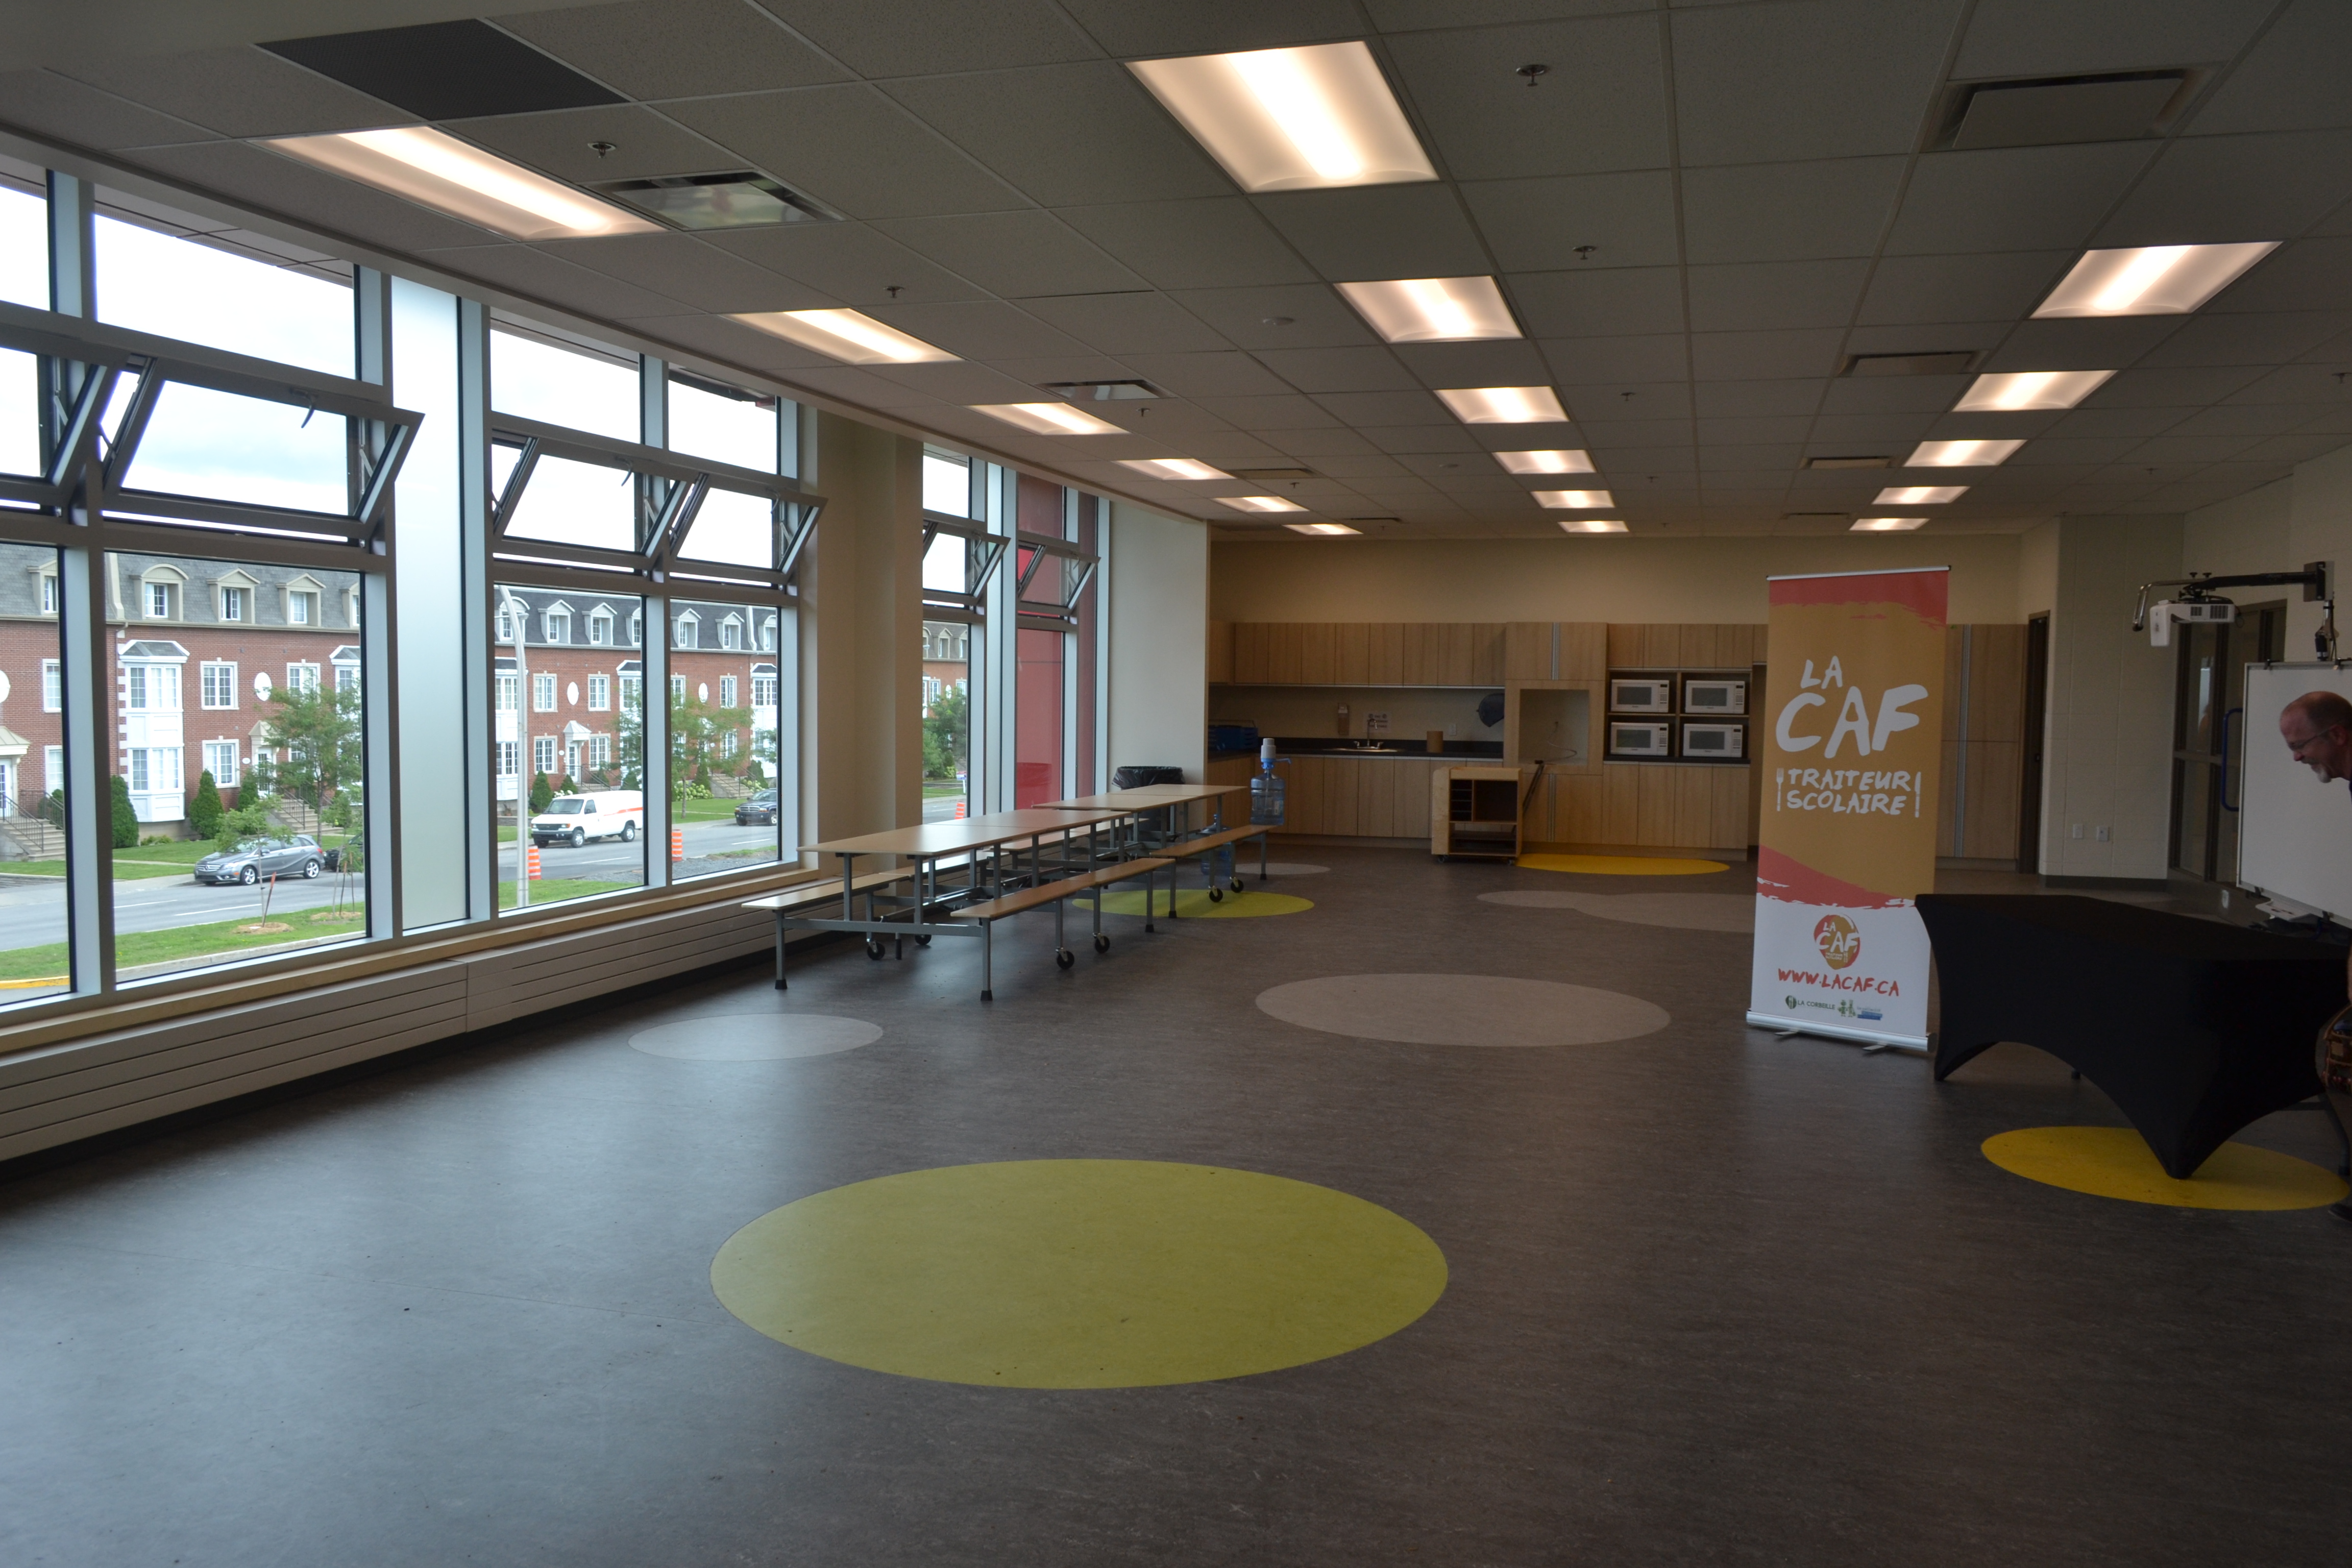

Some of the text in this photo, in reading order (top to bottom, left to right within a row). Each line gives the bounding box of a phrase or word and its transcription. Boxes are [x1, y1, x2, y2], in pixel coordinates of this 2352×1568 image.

[1800, 655, 1843, 689] LA
[1776, 684, 1928, 758] CAF
[1787, 768, 1911, 792] TRAITEUR
[1786, 790, 1907, 815] SCOLAIRE
[1823, 922, 1836, 932] LA
[1816, 931, 1860, 952] CAF
[1778, 968, 1899, 996] WWW.LACAF.CA
[1806, 1001, 1836, 1010] CORBEILLE
